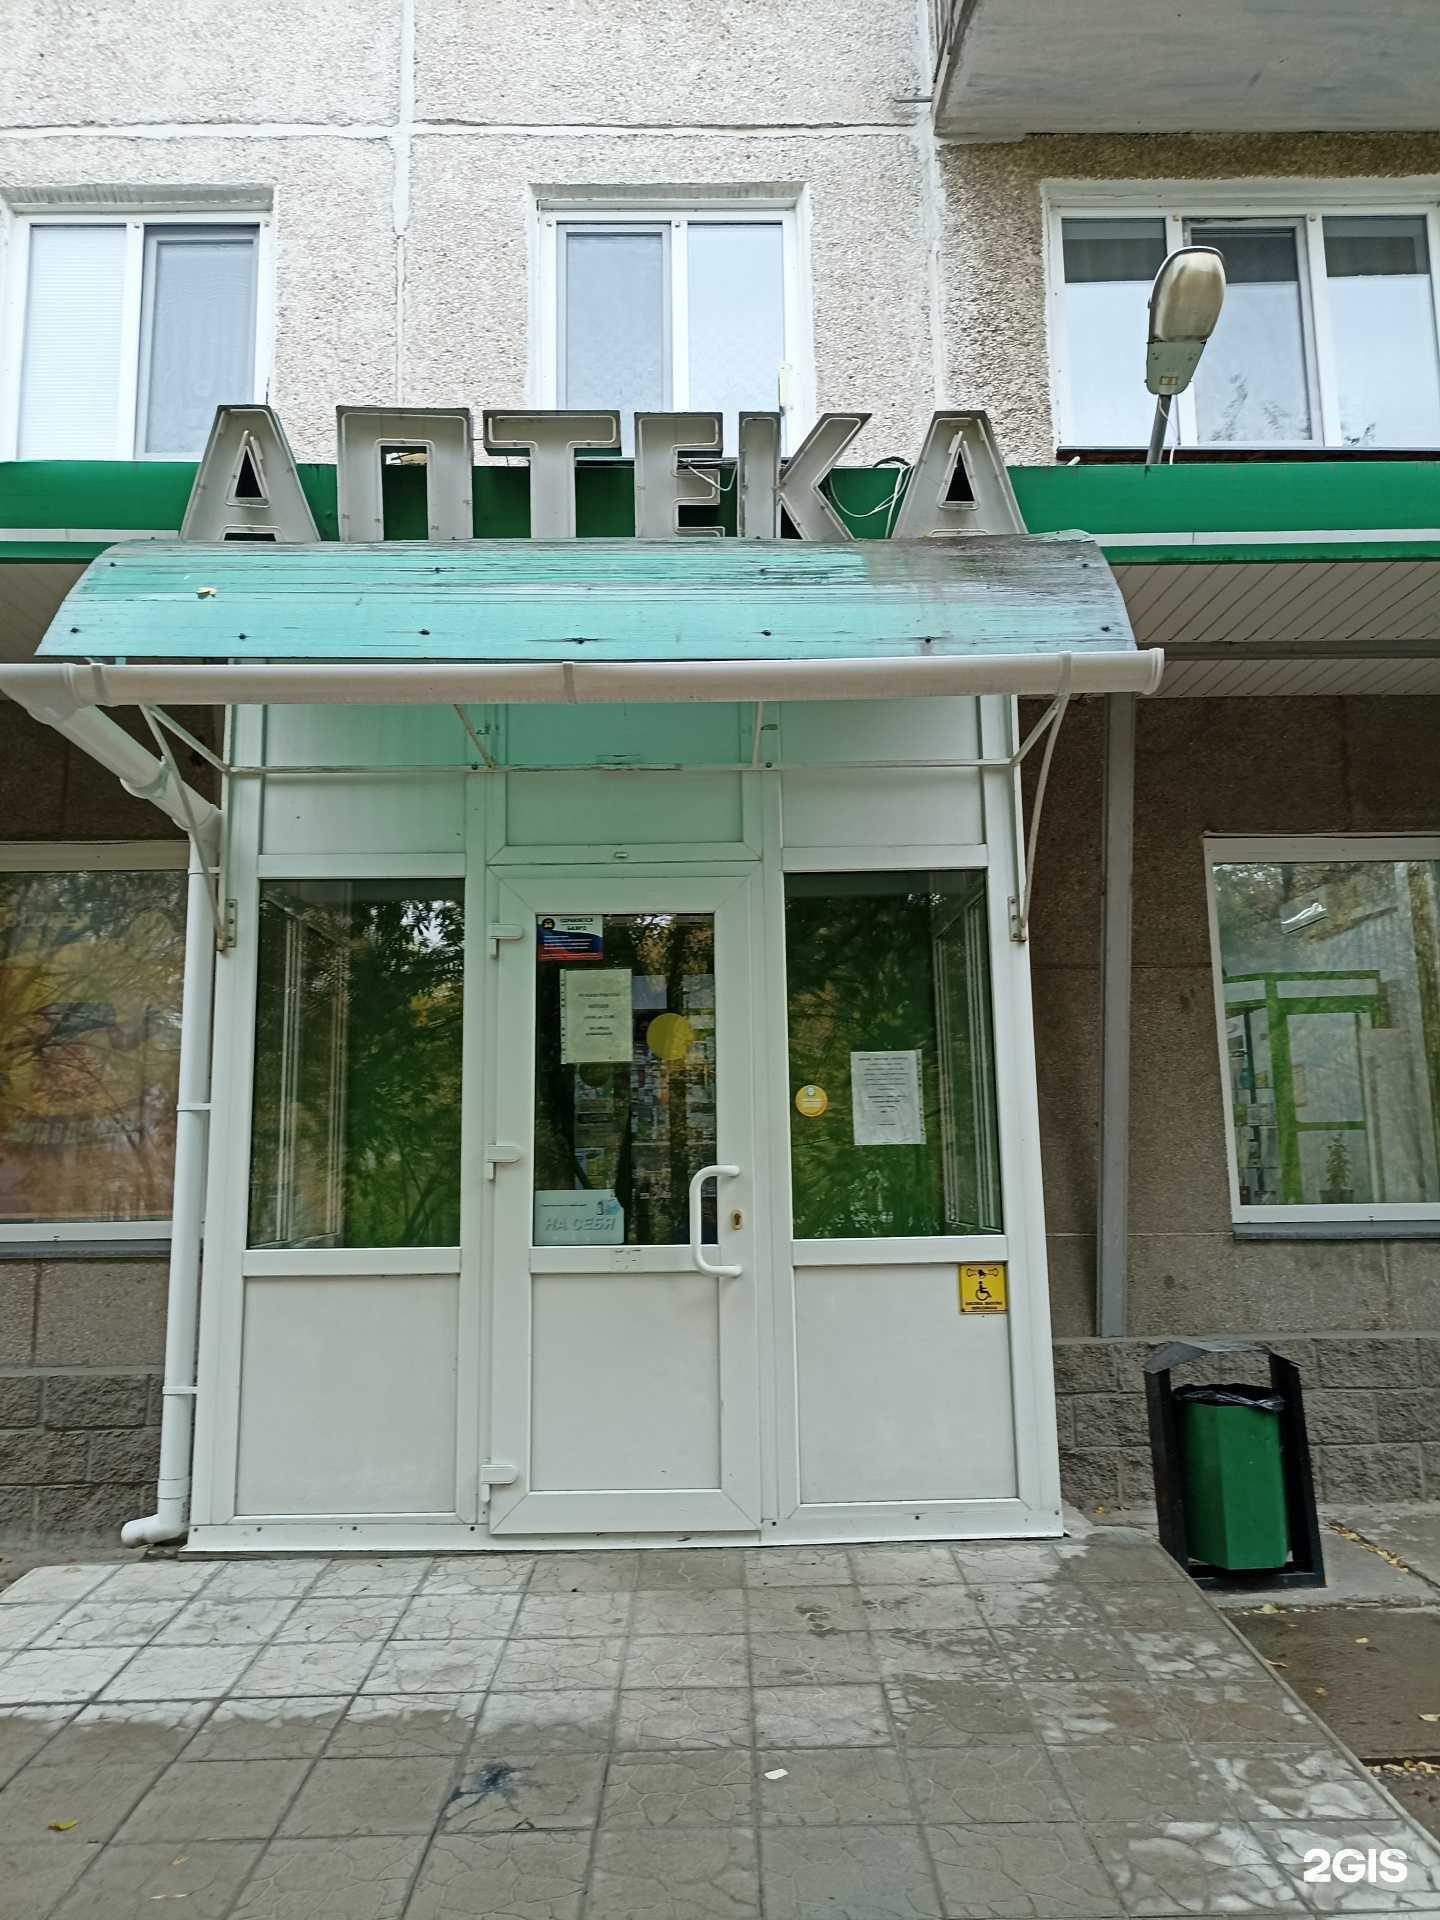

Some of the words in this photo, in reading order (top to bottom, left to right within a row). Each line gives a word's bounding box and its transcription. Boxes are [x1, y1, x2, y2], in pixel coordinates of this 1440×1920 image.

[180, 405, 1030, 540] АПТЕКА
[545, 1217, 568, 1231] НА
[573, 1217, 617, 1231] СЕБЯ
